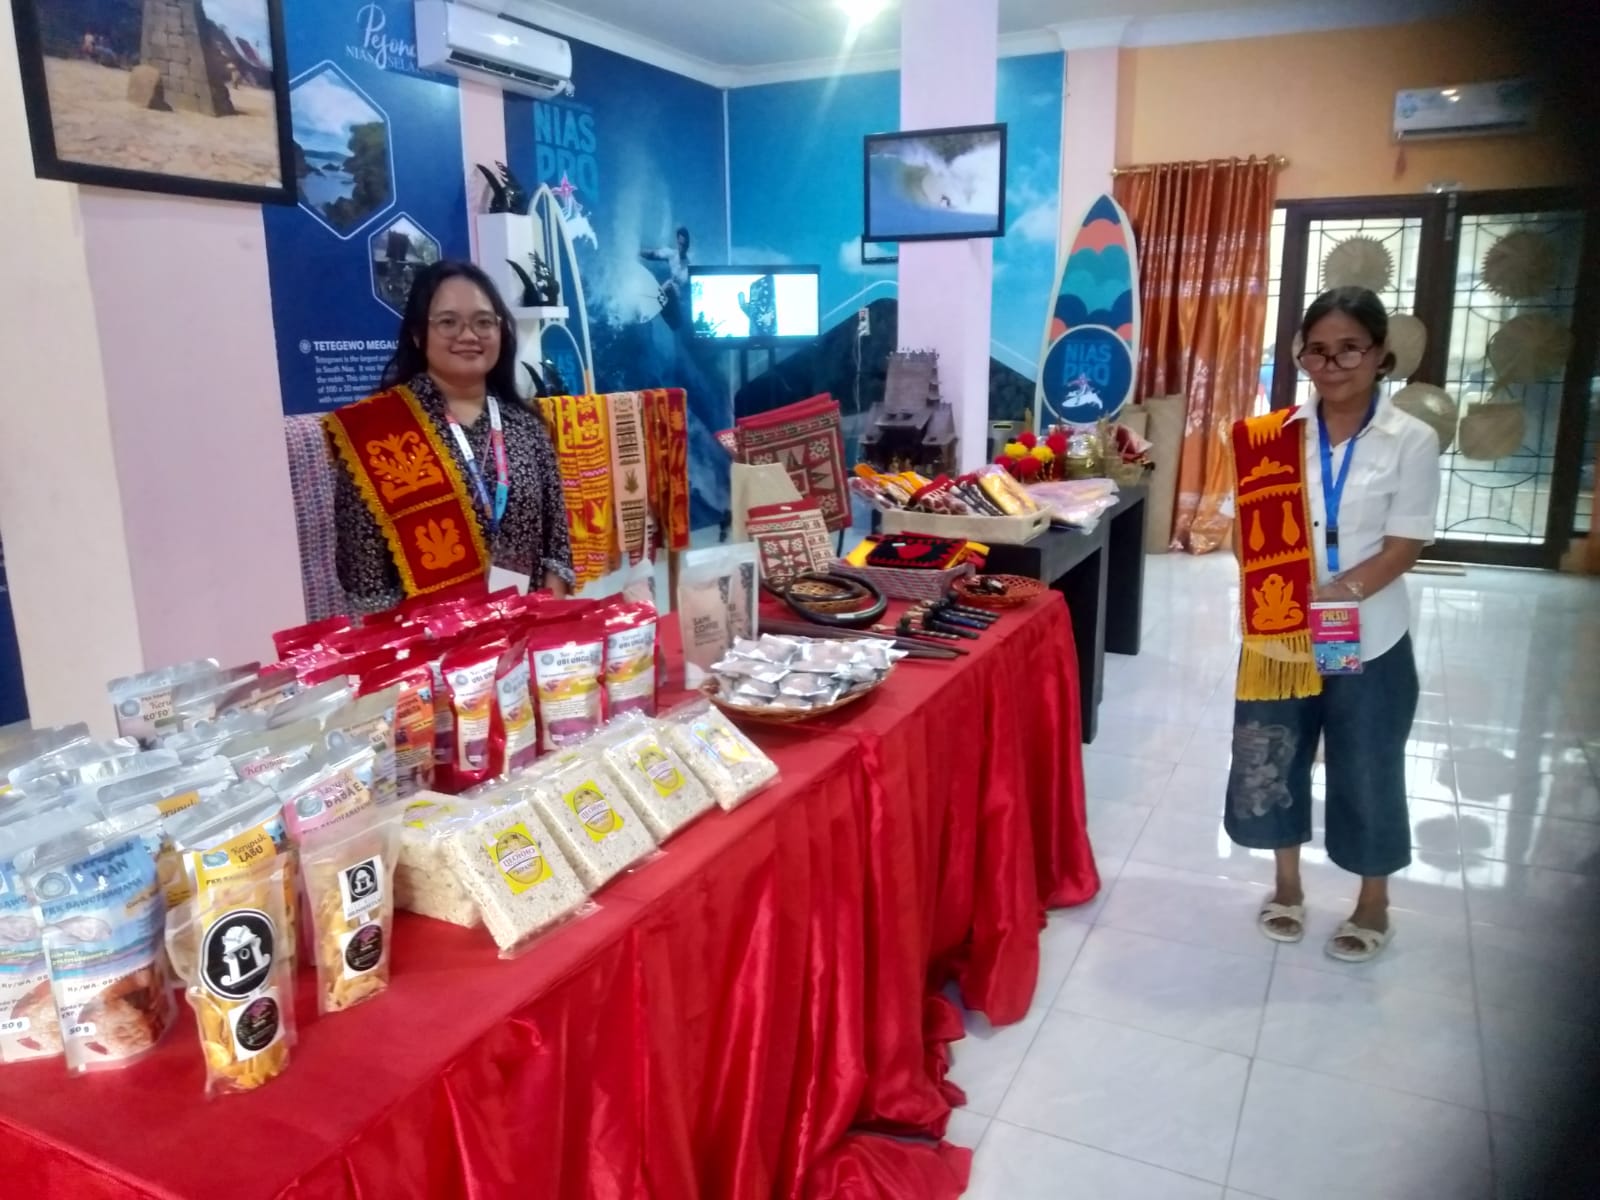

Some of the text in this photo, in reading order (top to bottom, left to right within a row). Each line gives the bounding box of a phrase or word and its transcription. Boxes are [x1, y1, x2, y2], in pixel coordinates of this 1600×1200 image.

[533, 101, 596, 153] NIAS
[536, 143, 598, 203] PRO
[313, 340, 365, 352] TETEGEWO
[1065, 343, 1112, 362] NIAS
[238, 845, 264, 863] LABU
